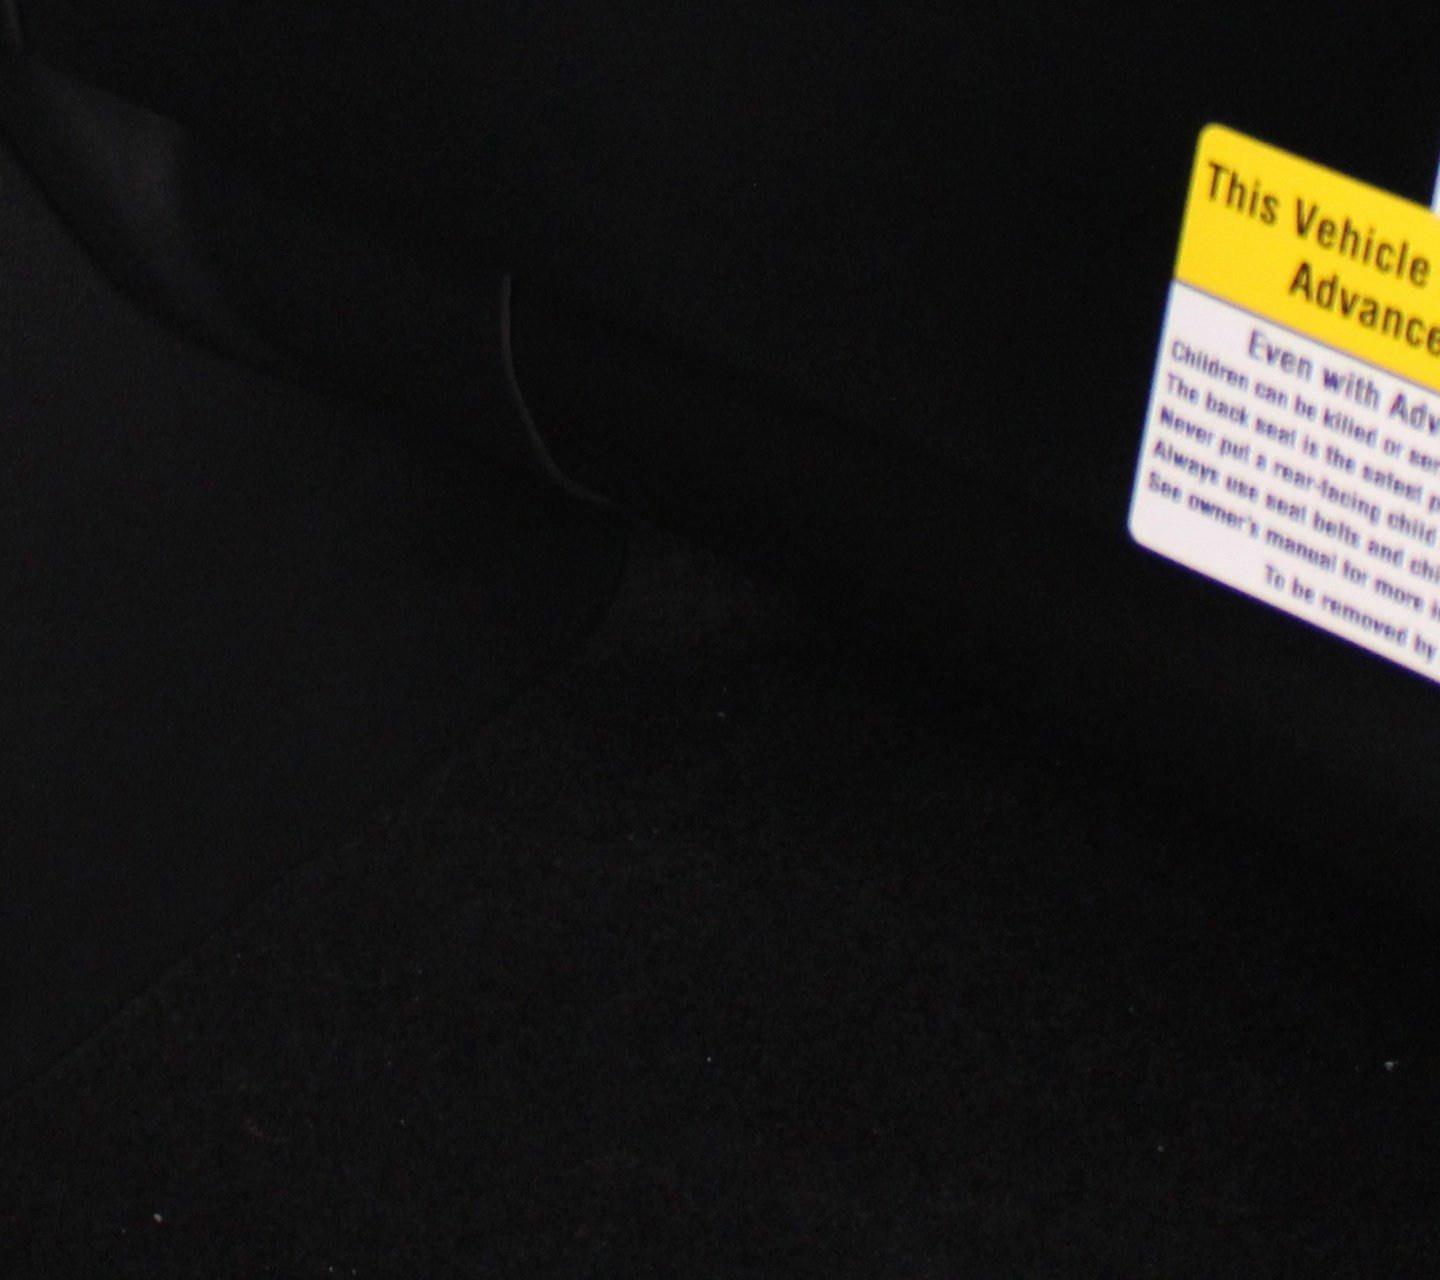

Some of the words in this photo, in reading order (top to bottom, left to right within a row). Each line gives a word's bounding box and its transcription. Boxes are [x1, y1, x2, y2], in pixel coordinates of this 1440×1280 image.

[1207, 159, 1279, 225] This
[1294, 196, 1430, 287] Vehicle
[1170, 339, 1248, 389] Children
[1253, 381, 1288, 406] can
[1293, 393, 1316, 420] be
[1321, 406, 1377, 447] killed
[1381, 436, 1403, 458] or
[1247, 328, 1312, 380] Even
[1321, 367, 1379, 409] with
[1158, 404, 1213, 444] Never
[1217, 436, 1250, 462] put
[1254, 452, 1267, 471] a
[1272, 460, 1380, 524] rear-facing
[1385, 511, 1437, 545] child
[1166, 371, 1199, 403] The
[1204, 391, 1248, 425] back
[1254, 416, 1296, 447] seat
[1301, 434, 1318, 457] is
[1324, 444, 1355, 473] the
[1361, 464, 1422, 502] safest
[1147, 469, 1181, 501] See
[1187, 493, 1258, 537] owner's
[1264, 527, 1337, 571] manual
[1341, 558, 1368, 585] for
[1373, 576, 1423, 611] more
[1152, 438, 1219, 483] Always
[1224, 475, 1258, 501] use
[1264, 492, 1306, 522] seat
[1311, 509, 1360, 547] belts
[1365, 537, 1404, 566] and
[1264, 562, 1285, 590] To
[1290, 576, 1315, 603] be
[1320, 594, 1408, 645] removed
[1412, 633, 1436, 662] by
